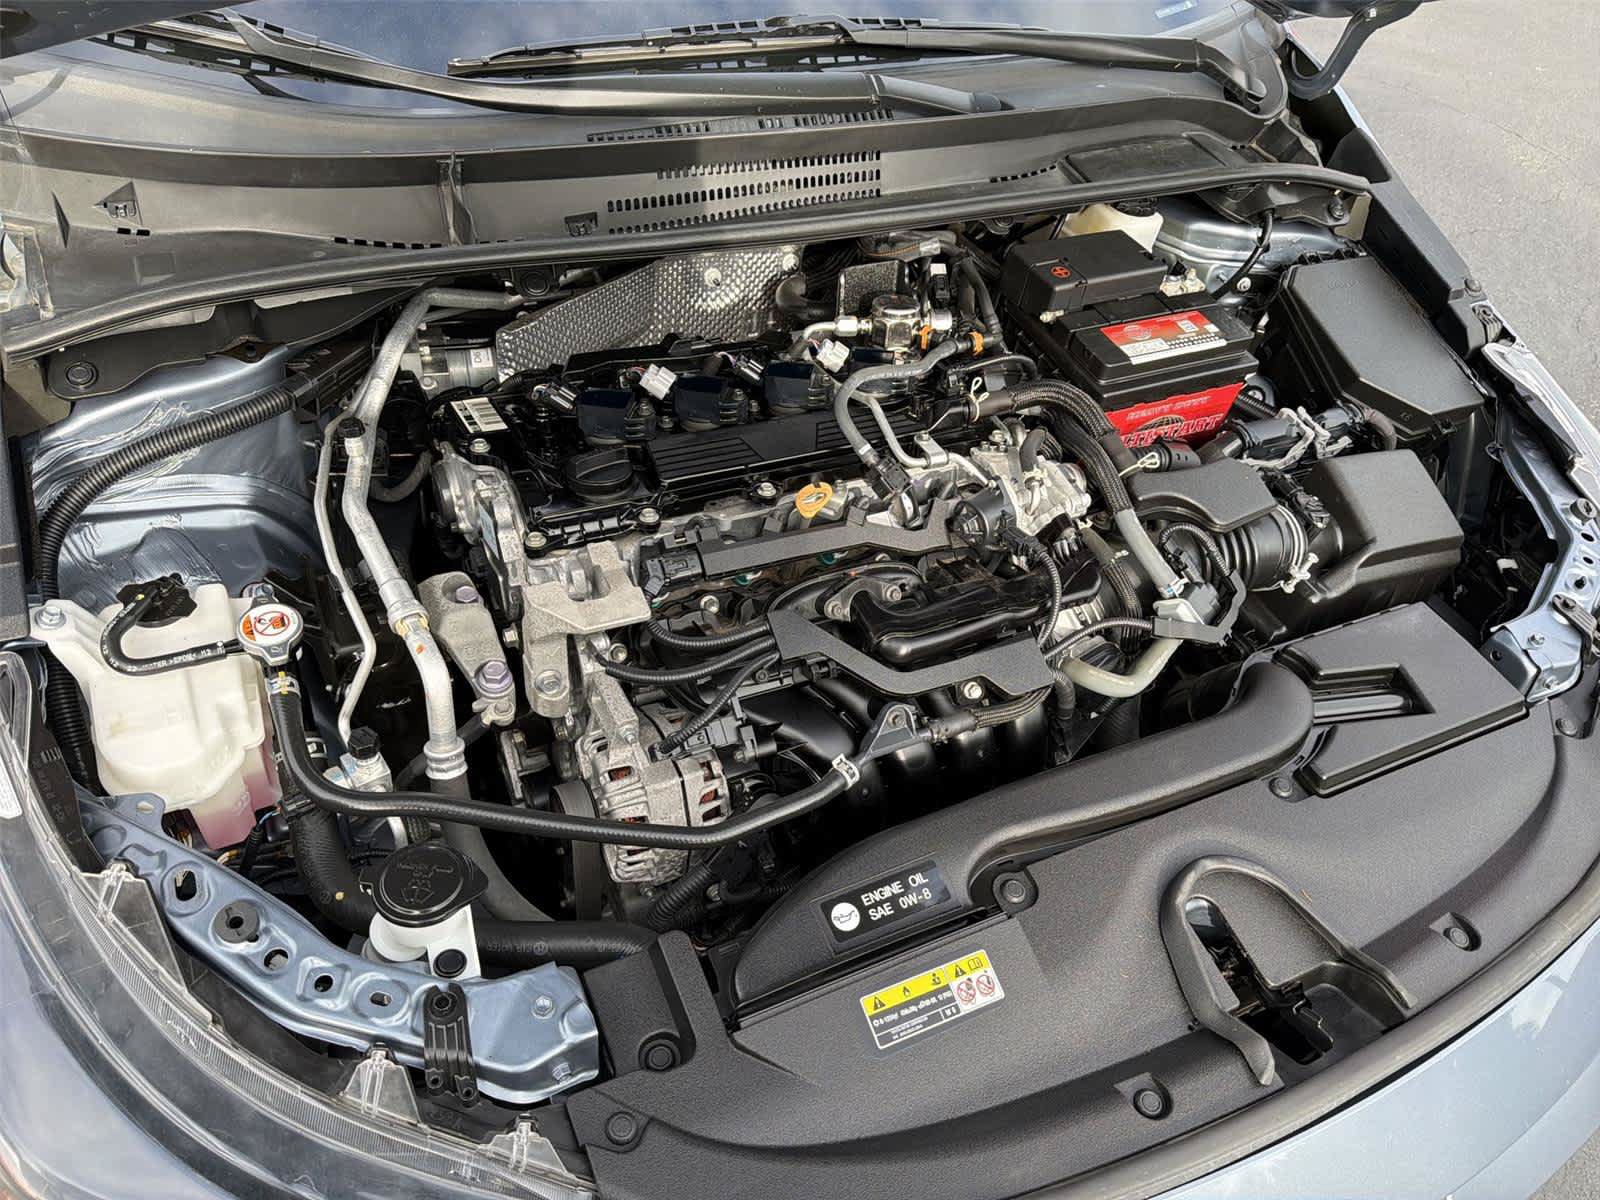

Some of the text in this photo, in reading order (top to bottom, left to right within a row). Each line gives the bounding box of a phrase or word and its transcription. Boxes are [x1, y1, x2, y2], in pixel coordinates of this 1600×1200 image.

[861, 872, 929, 906] ENGINE OIL
[868, 888, 932, 921] SAE 0W-8
